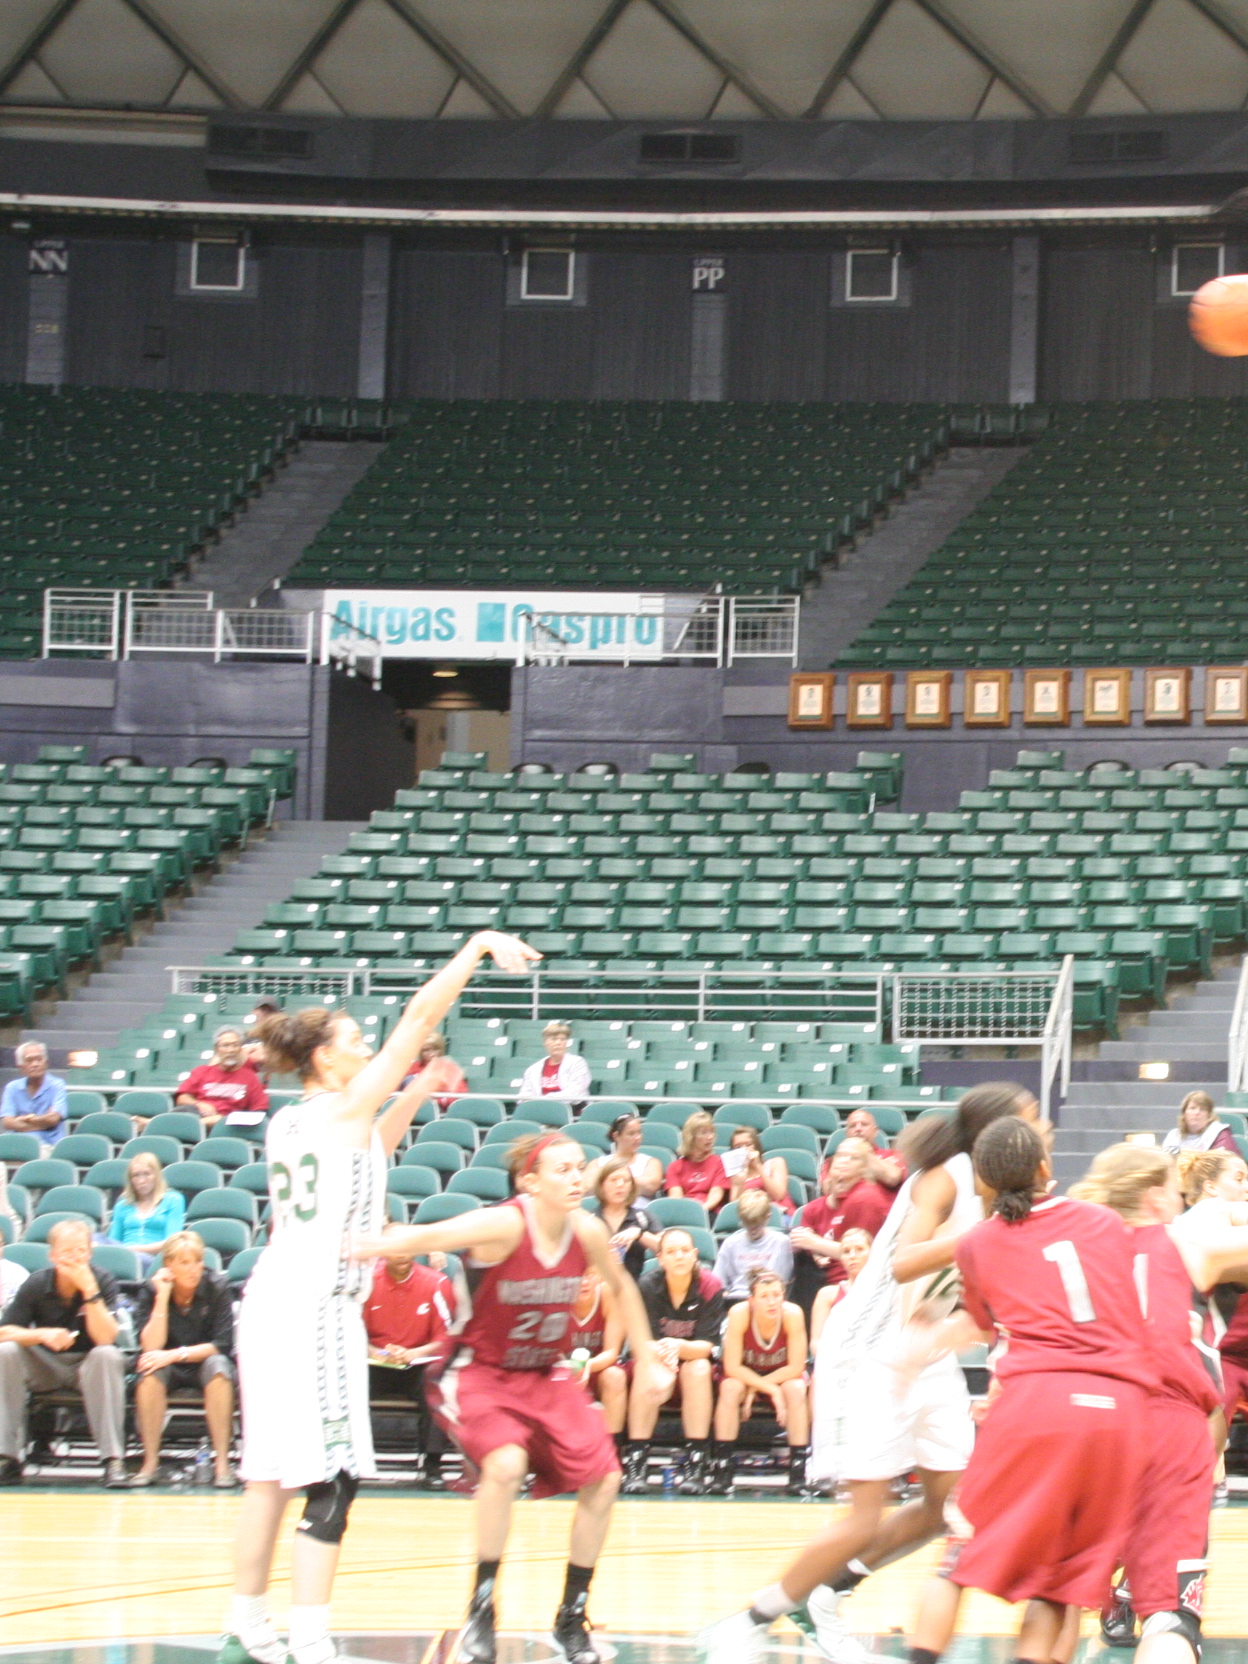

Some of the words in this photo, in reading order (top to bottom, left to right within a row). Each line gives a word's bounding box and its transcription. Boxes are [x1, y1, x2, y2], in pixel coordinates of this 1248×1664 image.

[29, 249, 68, 272] NN
[692, 267, 725, 290] PP
[329, 600, 456, 645] Airgas
[1042, 1240, 1098, 1323] 1
